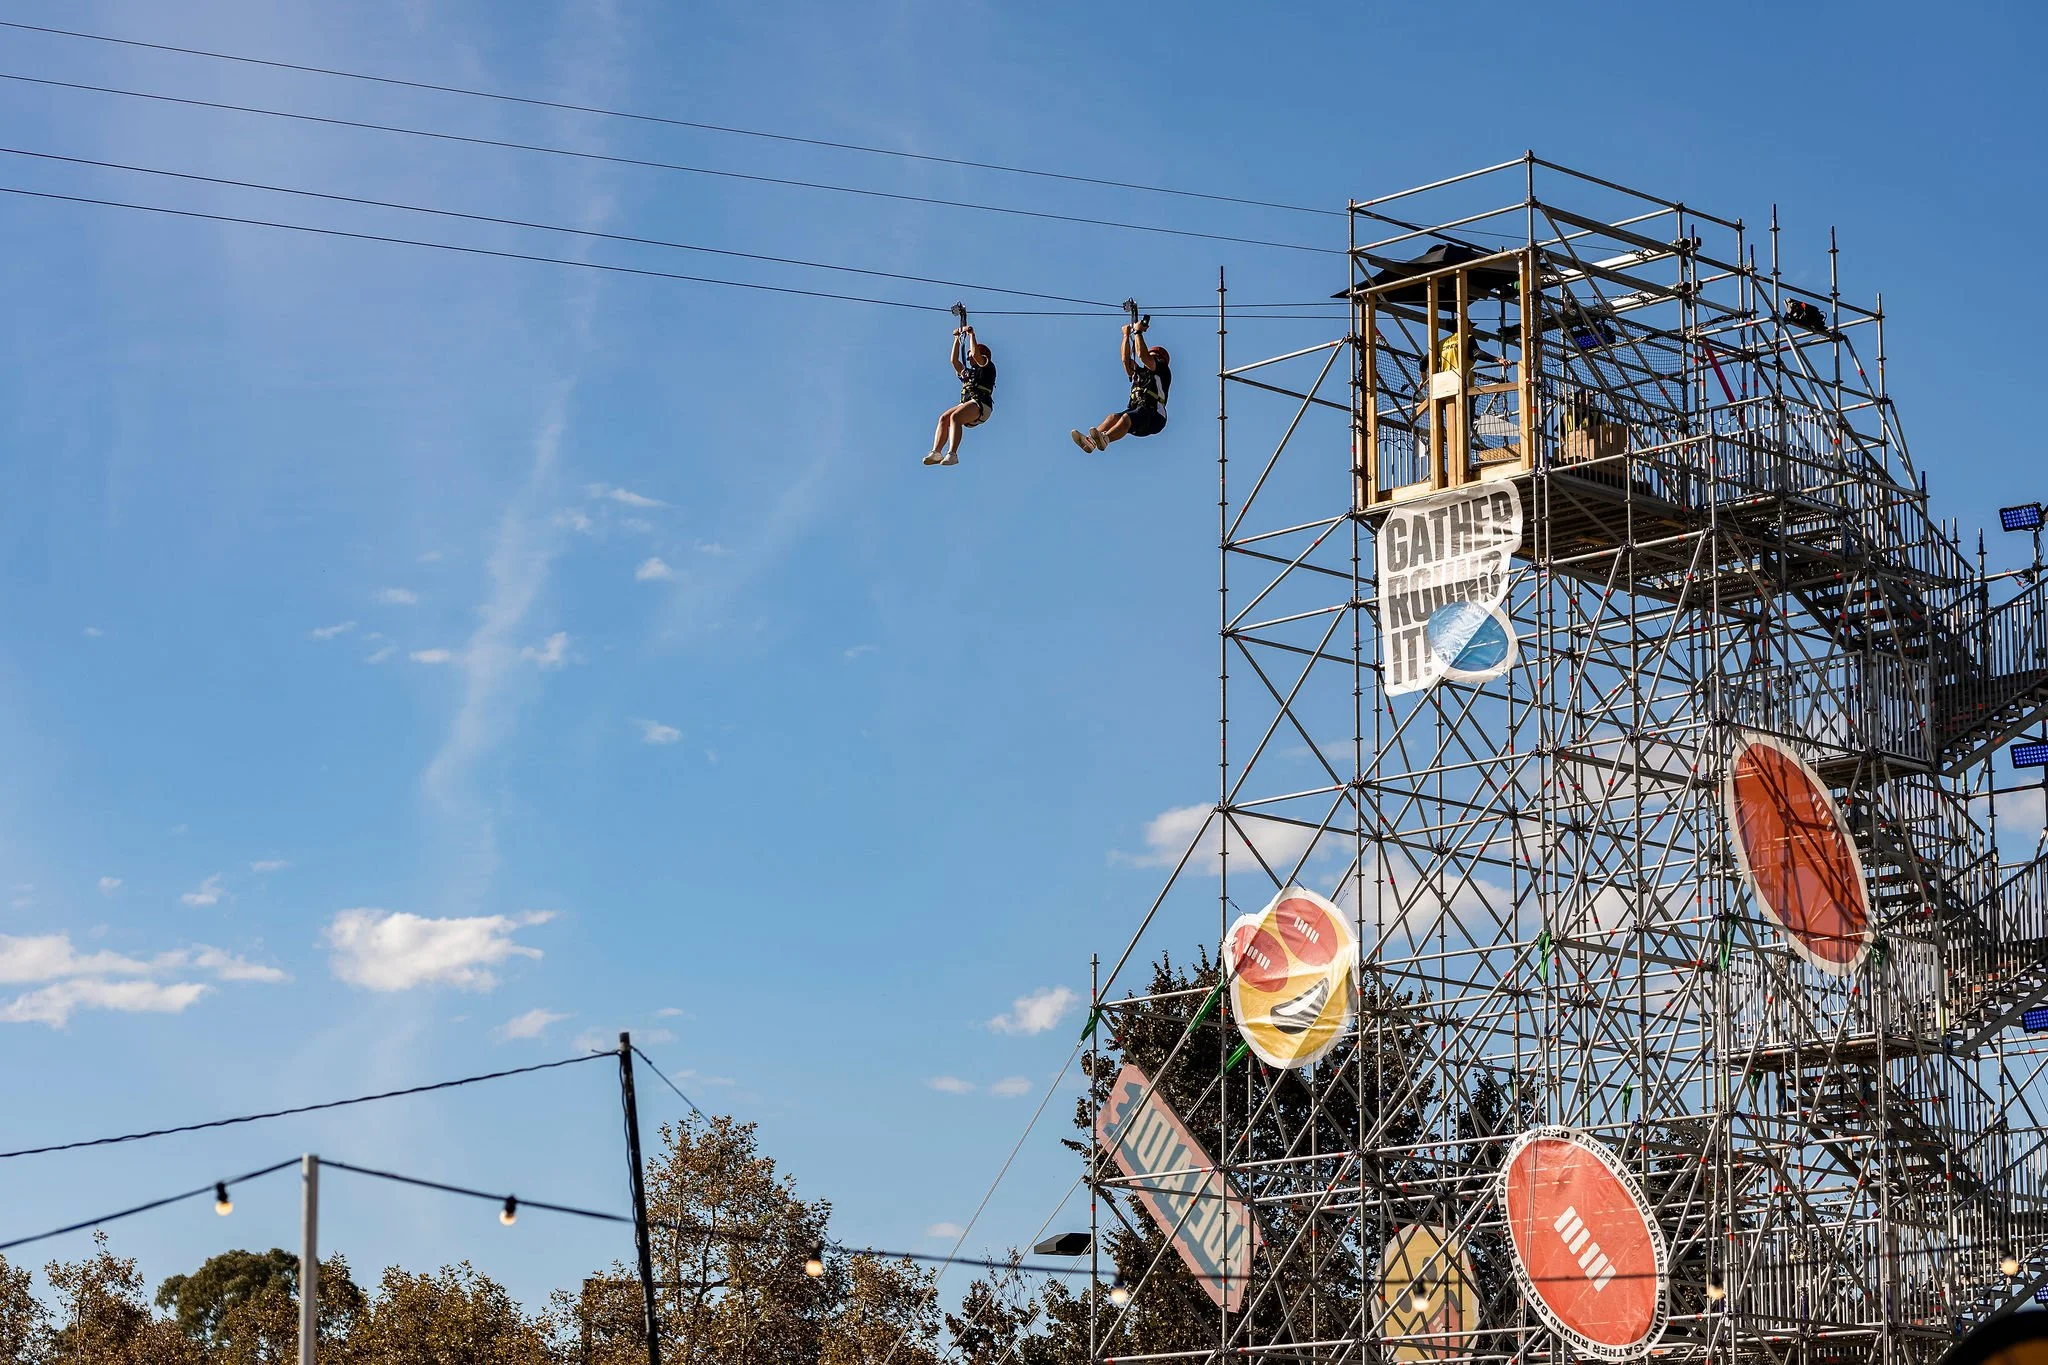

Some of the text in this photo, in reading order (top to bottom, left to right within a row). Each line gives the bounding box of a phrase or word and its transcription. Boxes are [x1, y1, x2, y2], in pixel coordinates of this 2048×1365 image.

[1386, 490, 1514, 573] GATHER
[1617, 1169, 1650, 1217] ROUND
[1647, 1219, 1666, 1284] GATHER
[1549, 1316, 1589, 1349] ROUND
[1646, 1289, 1666, 1344] ROUND
[1592, 1343, 1645, 1358] GATHER
